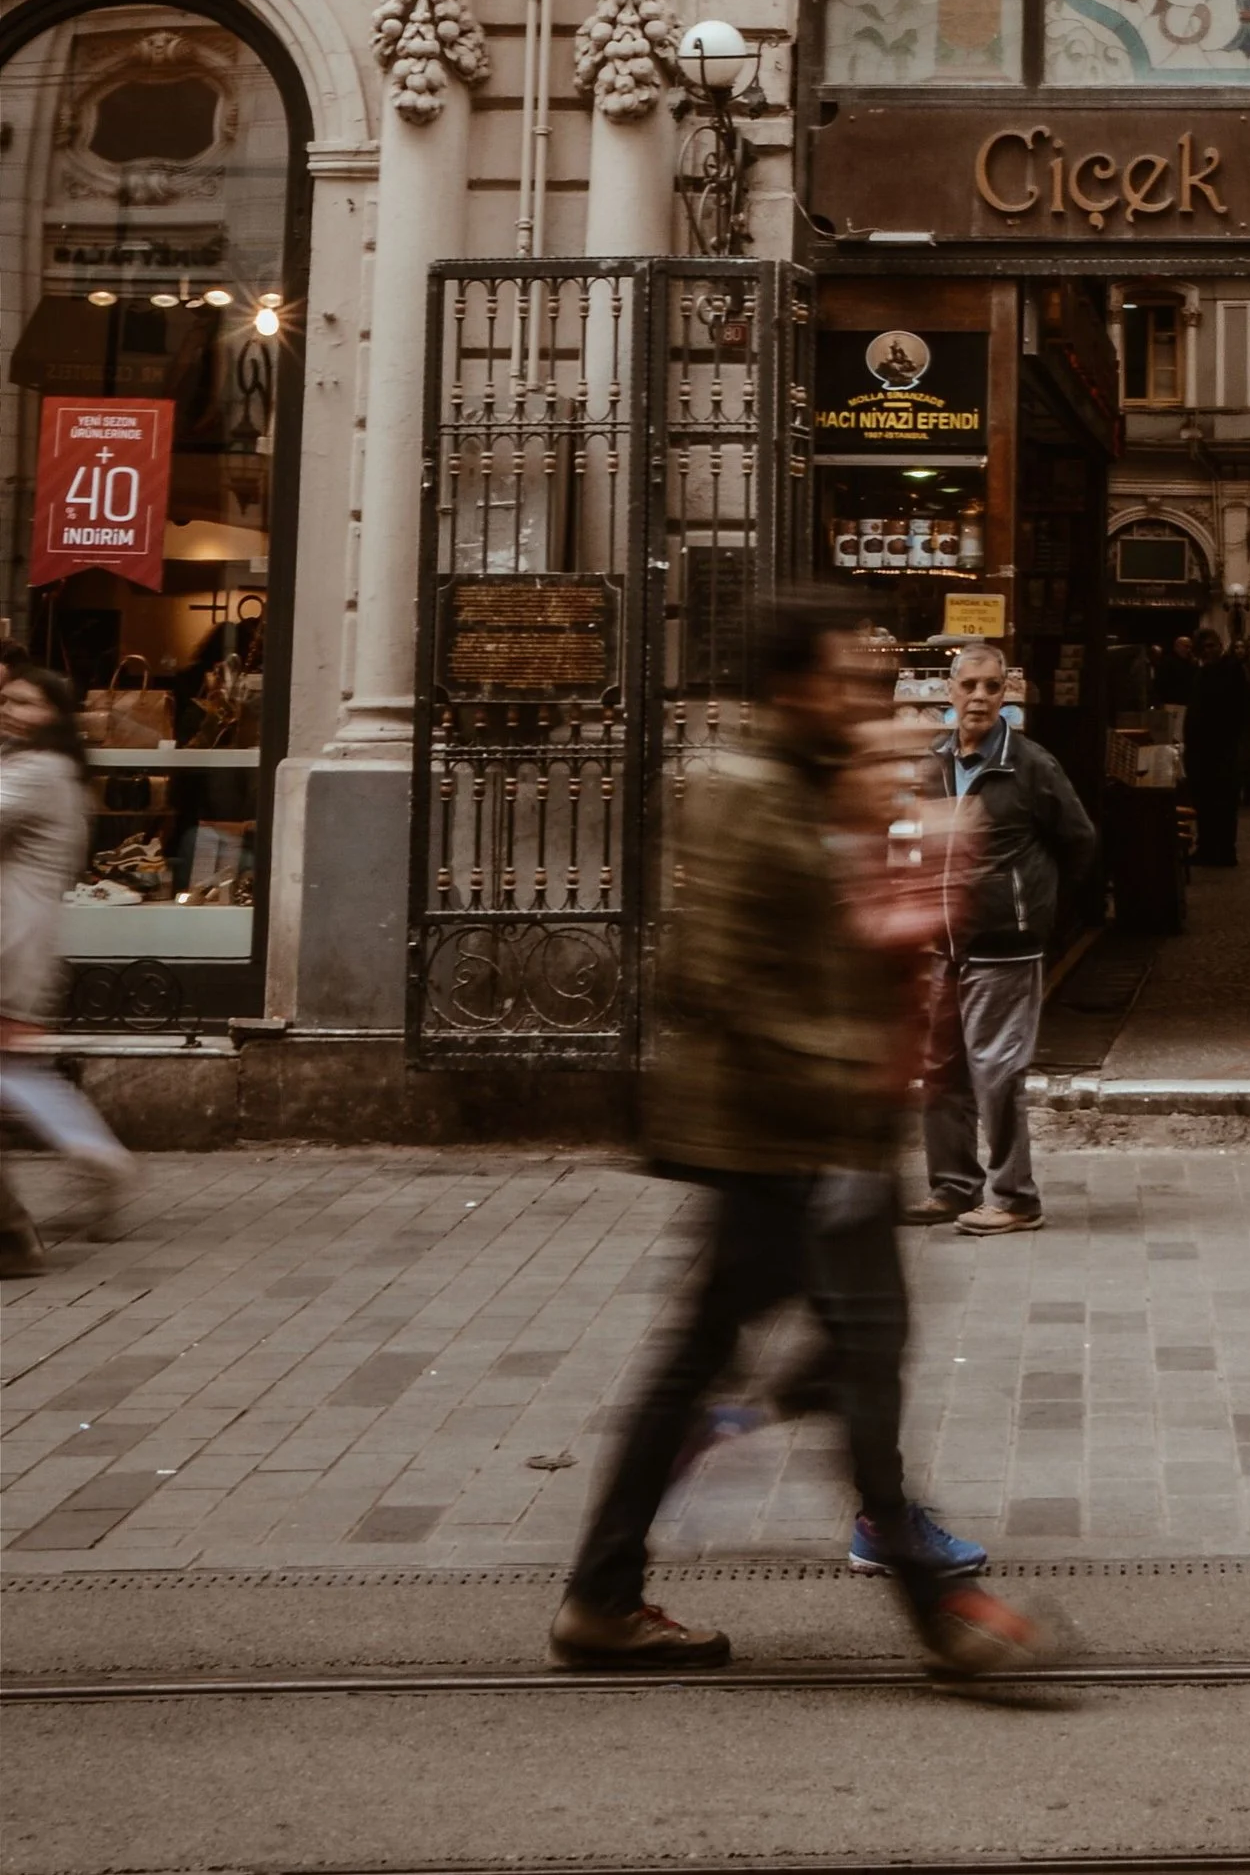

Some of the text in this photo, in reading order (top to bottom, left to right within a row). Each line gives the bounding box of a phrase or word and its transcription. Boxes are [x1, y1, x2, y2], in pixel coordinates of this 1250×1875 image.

[723, 326, 742, 341] 80
[103, 416, 137, 427] SEZON
[815, 407, 979, 430] HACI NİYAZİ EFENDİ
